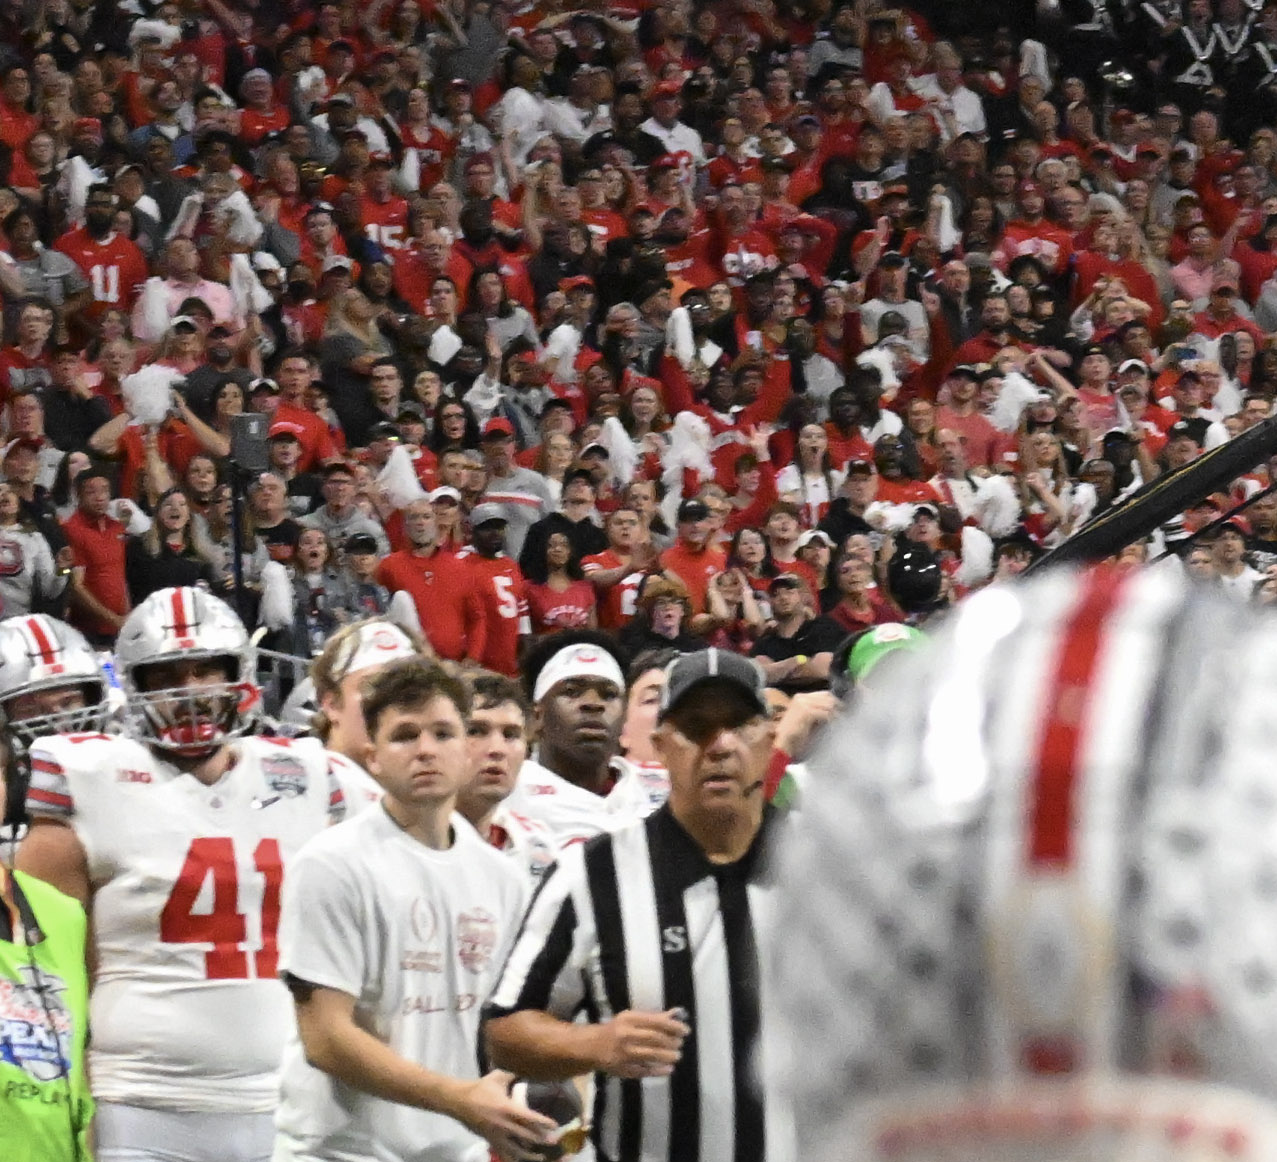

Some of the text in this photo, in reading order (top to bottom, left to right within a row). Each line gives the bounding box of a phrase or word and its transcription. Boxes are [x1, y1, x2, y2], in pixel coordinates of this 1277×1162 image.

[90, 265, 120, 303] 11
[493, 575, 518, 619] 5
[160, 836, 285, 980] 41
[662, 925, 687, 954] S
